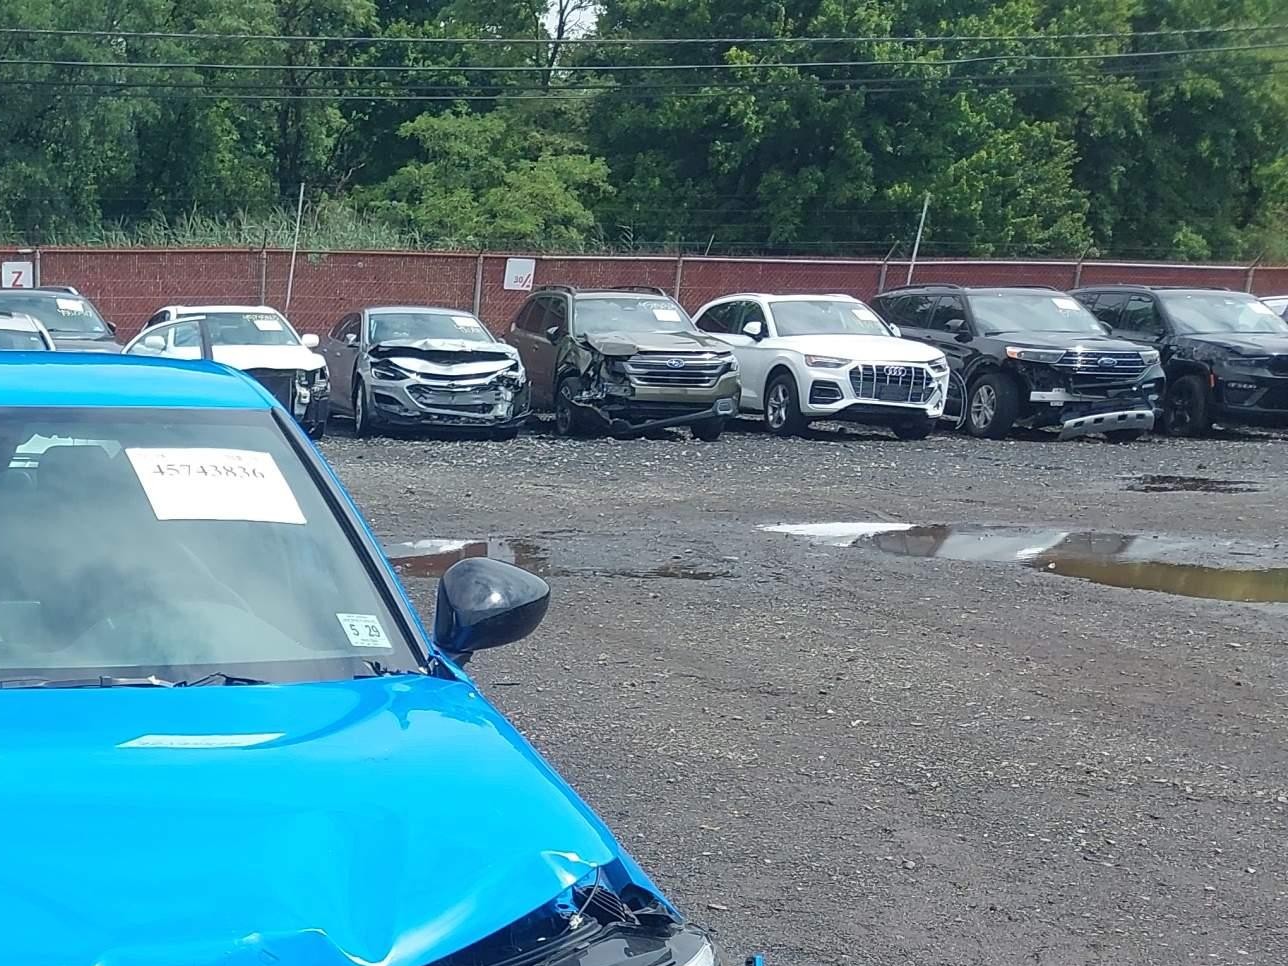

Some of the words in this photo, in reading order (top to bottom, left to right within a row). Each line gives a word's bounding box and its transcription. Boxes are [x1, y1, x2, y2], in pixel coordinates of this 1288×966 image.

[11, 271, 24, 287] Z
[152, 463, 266, 480] 45743836
[349, 623, 360, 637] 5
[364, 624, 381, 638] 29
